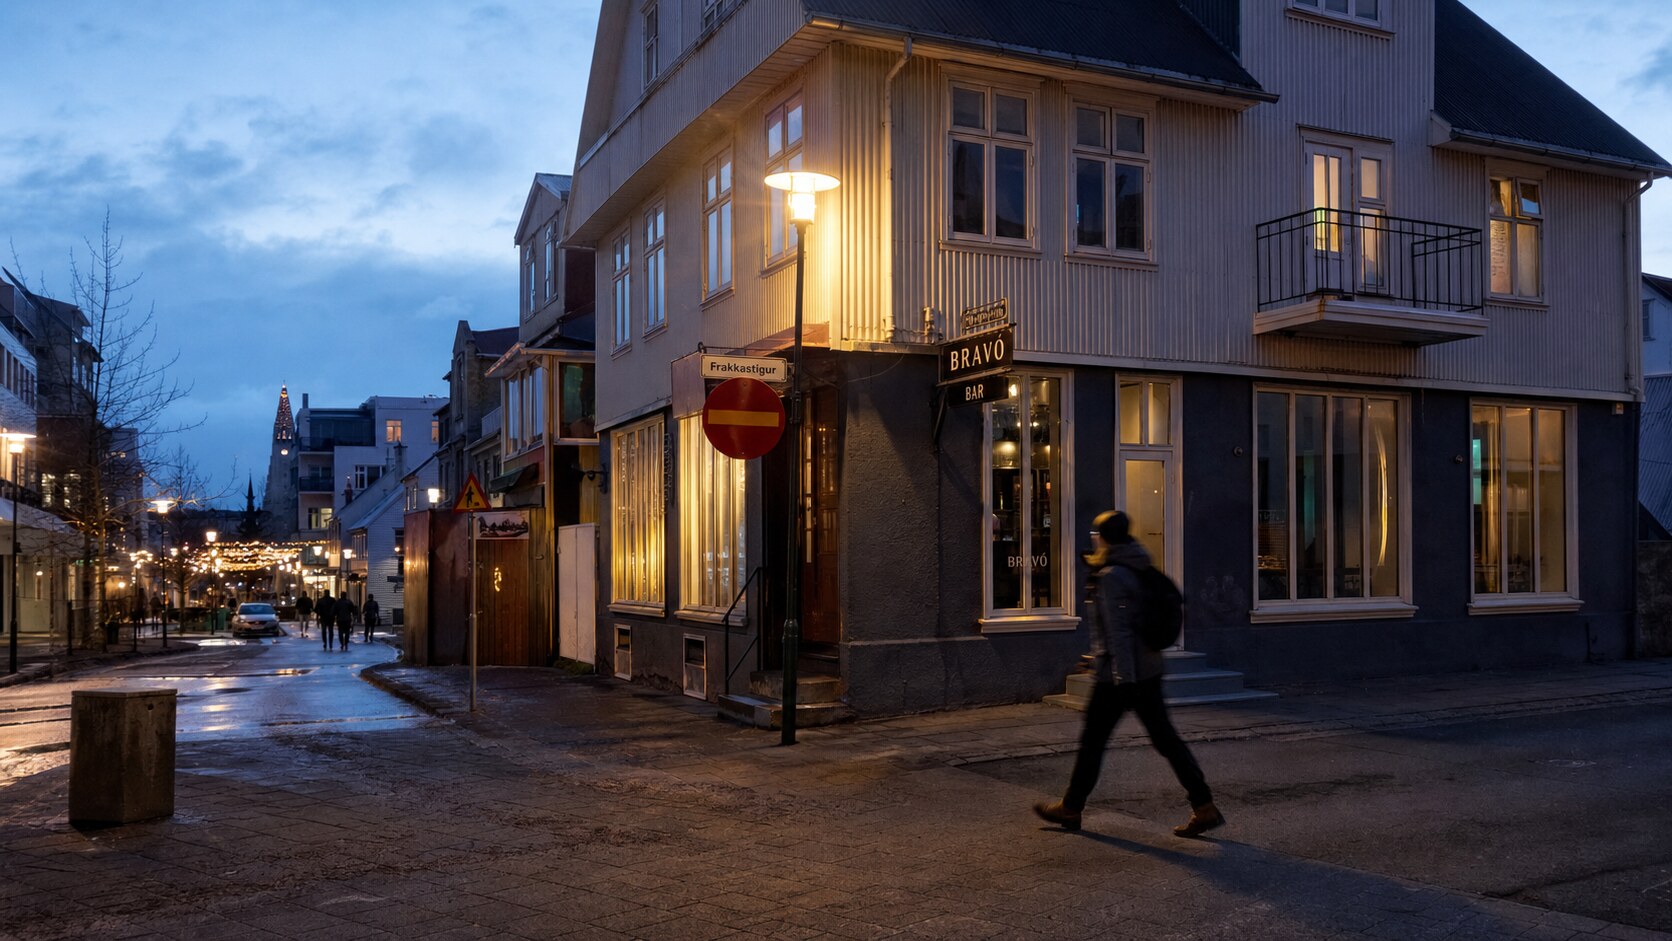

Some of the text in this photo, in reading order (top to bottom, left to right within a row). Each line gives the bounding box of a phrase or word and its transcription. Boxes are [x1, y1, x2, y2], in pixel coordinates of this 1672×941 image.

[950, 334, 1004, 371] BRAVÓ
[710, 361, 776, 376] Frakkastigur
[965, 384, 984, 401] BAR
[1007, 552, 1048, 568] BRVÓ
